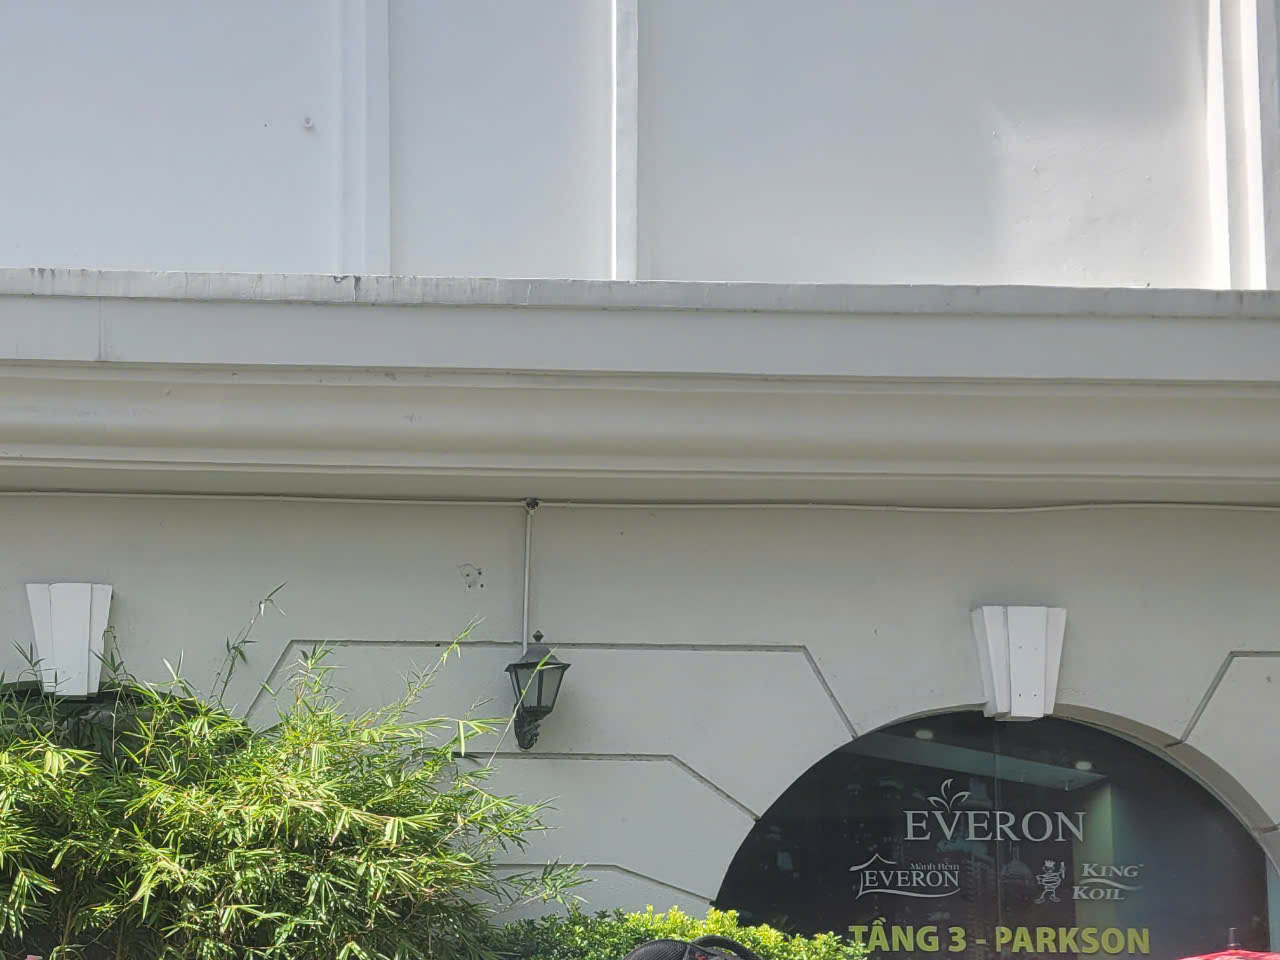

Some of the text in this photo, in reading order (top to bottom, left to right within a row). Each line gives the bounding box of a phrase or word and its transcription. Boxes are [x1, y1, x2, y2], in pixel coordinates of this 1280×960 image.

[903, 810, 1087, 842] EVERON
[863, 870, 960, 887] EVERON
[1081, 863, 1139, 878] KING
[948, 927, 966, 952] 3
[996, 927, 1150, 953] PARKSON
